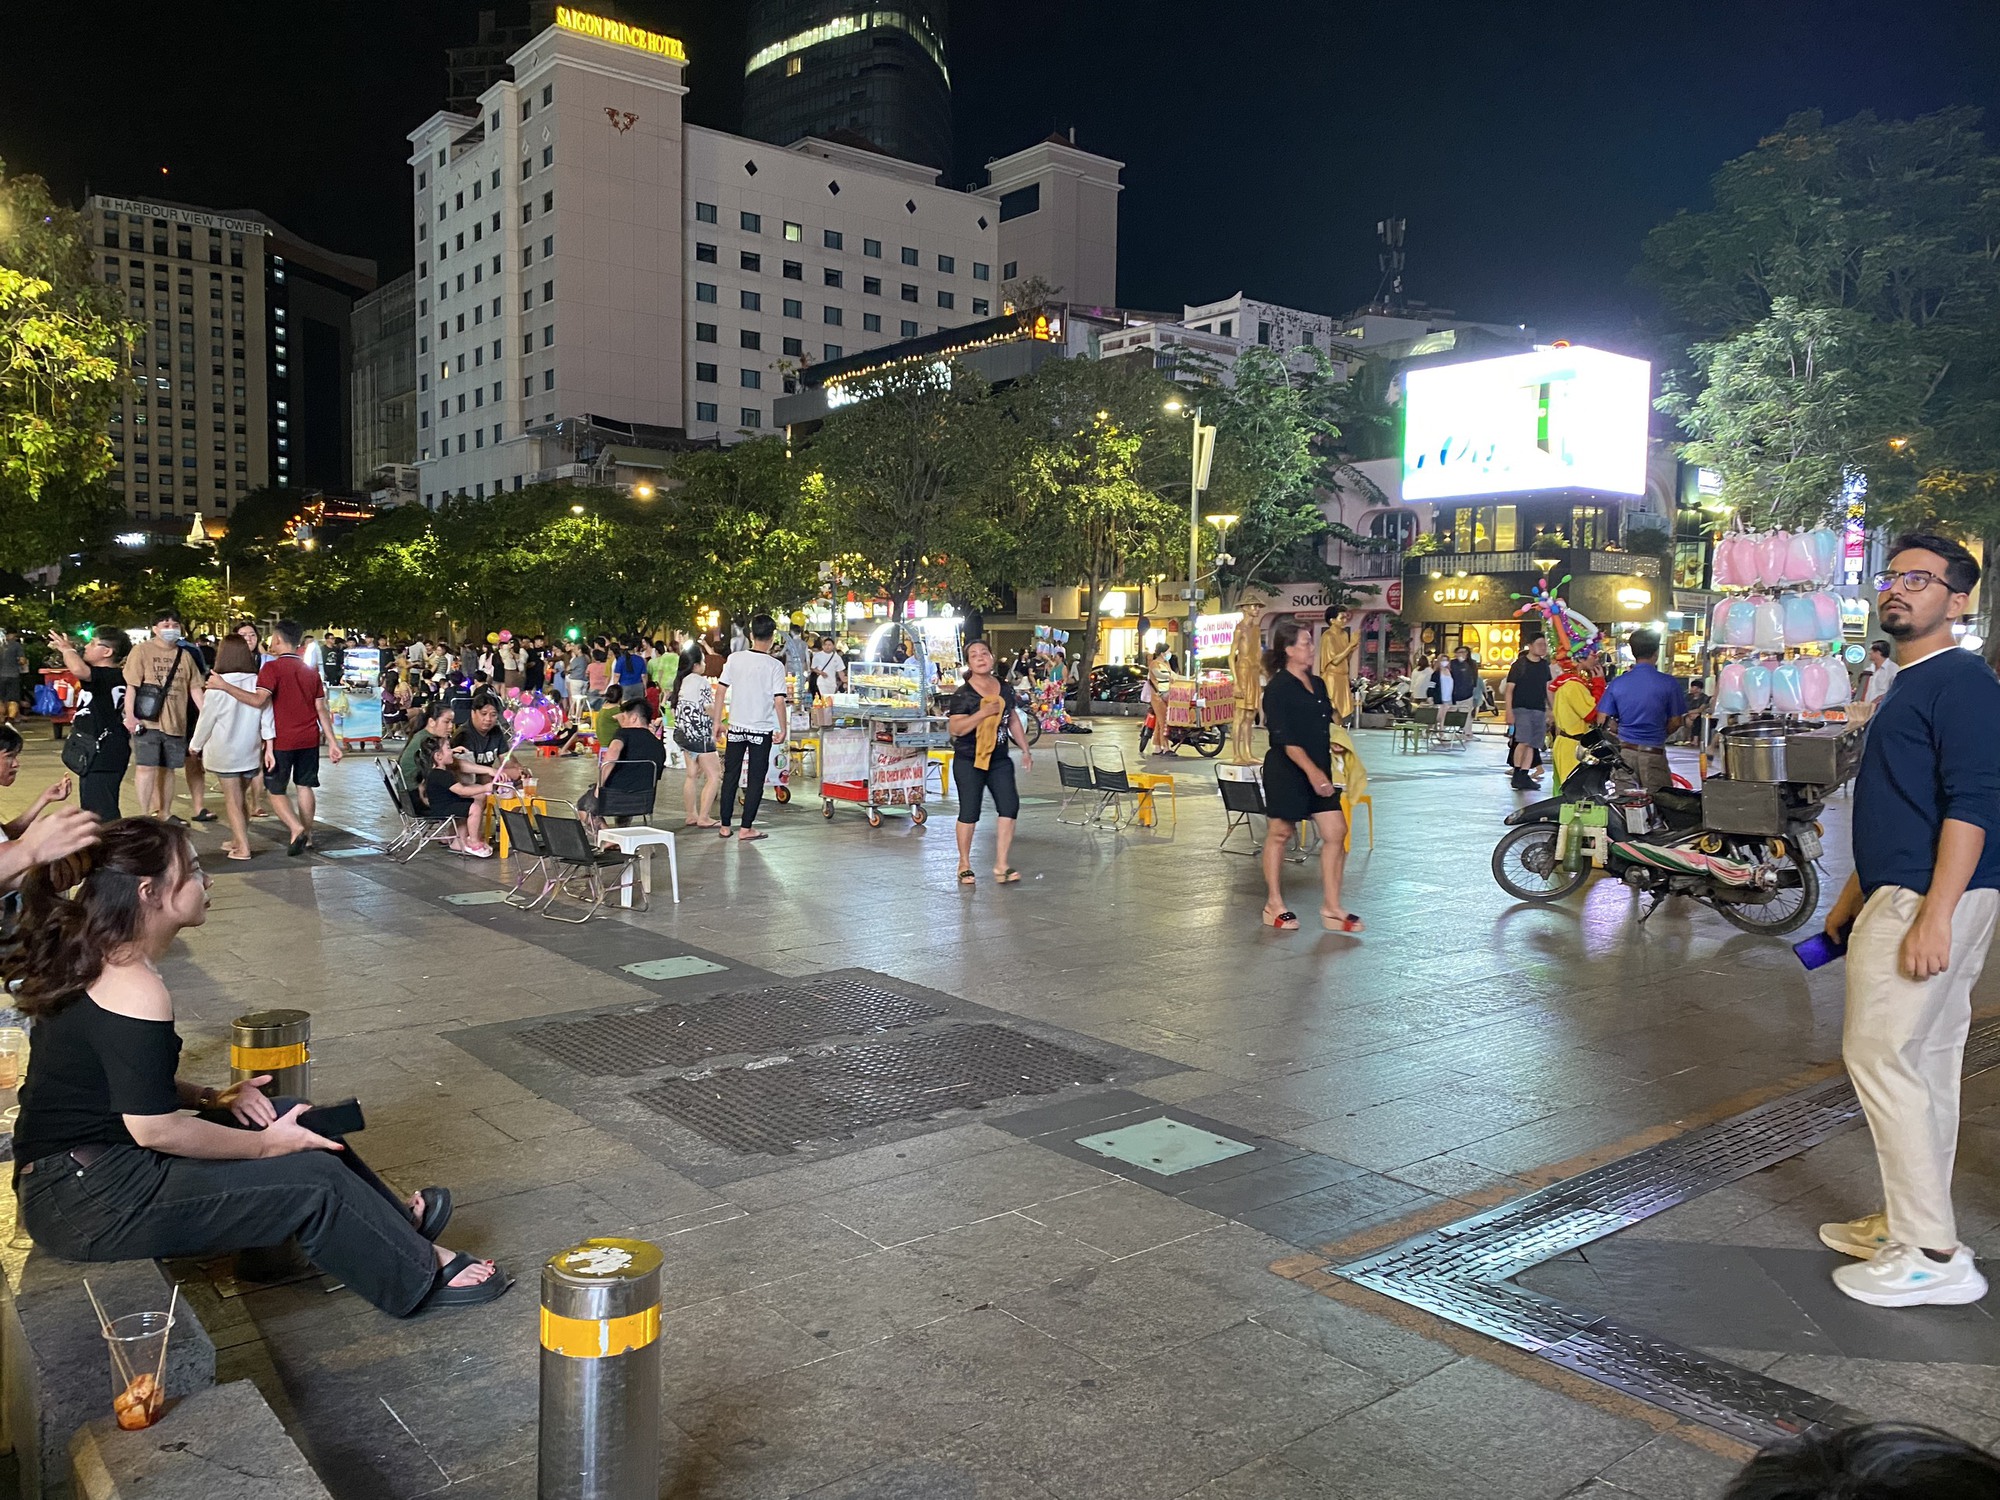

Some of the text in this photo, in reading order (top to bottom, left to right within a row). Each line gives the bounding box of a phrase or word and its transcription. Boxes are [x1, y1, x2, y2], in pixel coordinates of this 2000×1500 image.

[556, 5, 686, 60] SAIGON PRINCE HOTEL
[114, 200, 263, 234] HARBOUR VIEW TOWER
[1292, 588, 1352, 607] socioa
[1211, 631, 1232, 645] WON
[1214, 703, 1234, 721] WON
